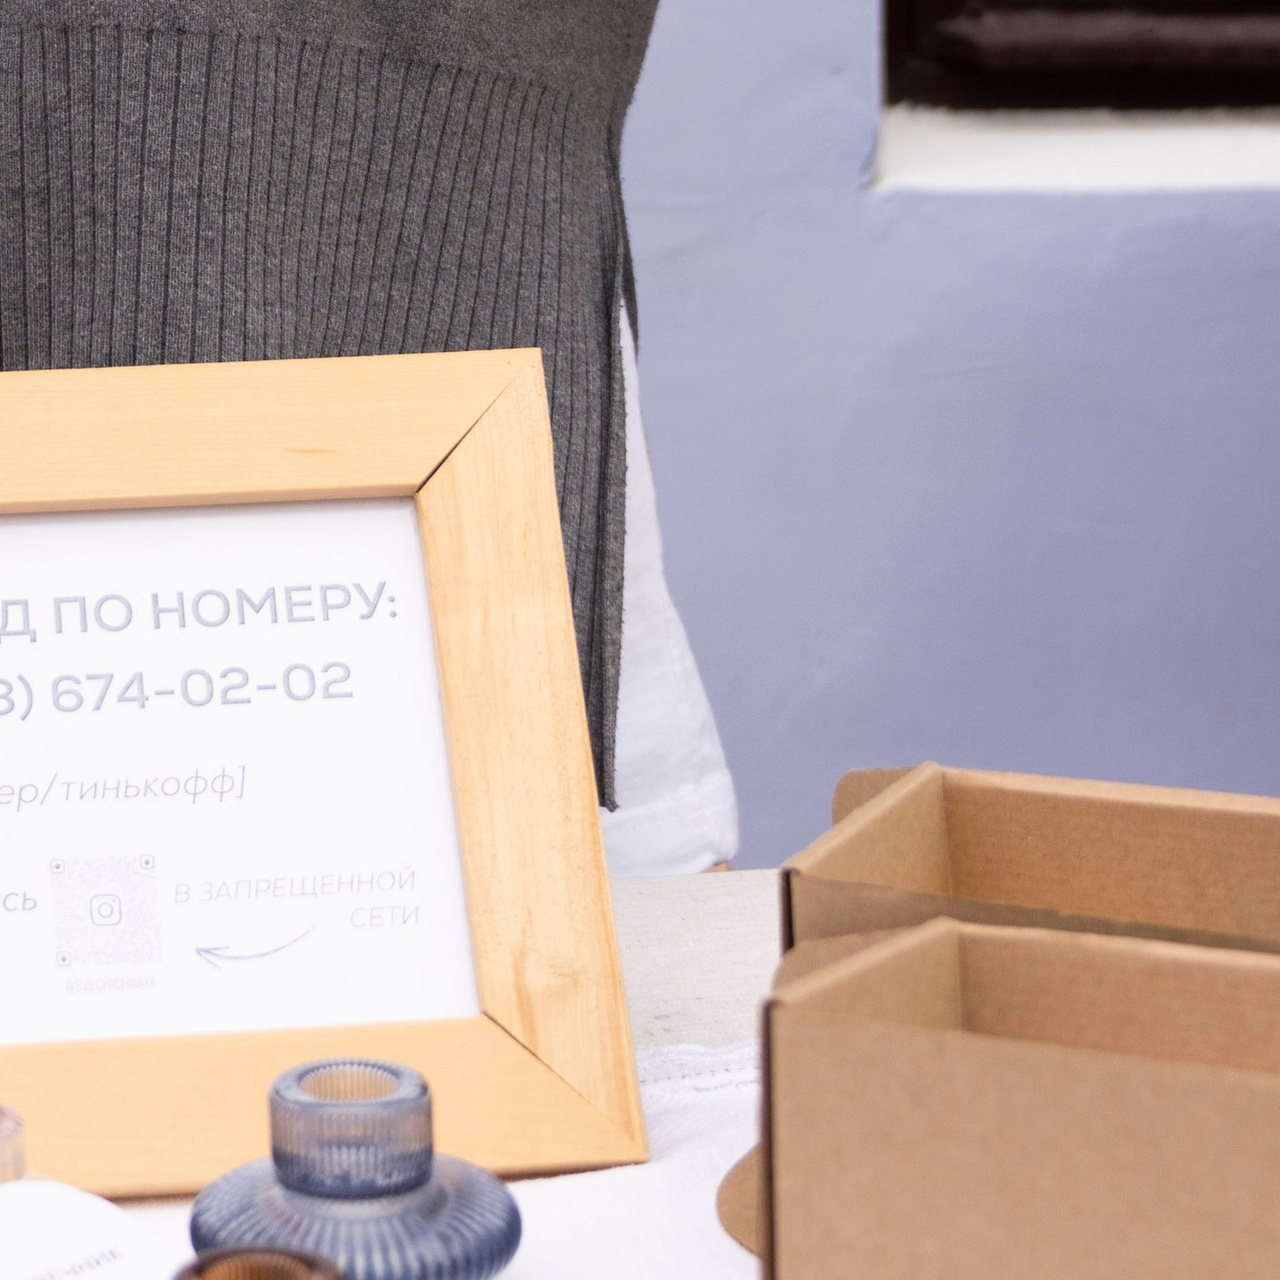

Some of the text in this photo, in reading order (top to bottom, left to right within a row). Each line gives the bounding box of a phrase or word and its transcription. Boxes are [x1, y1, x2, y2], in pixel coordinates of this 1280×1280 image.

[52, 593, 134, 635] ПО
[150, 580, 398, 631] НОМЕРУ:
[51, 661, 355, 714] 674-02-02
[173, 864, 417, 905] В ЗАПРЕЩЕННОЙ
[348, 903, 421, 929] СЕТИ
